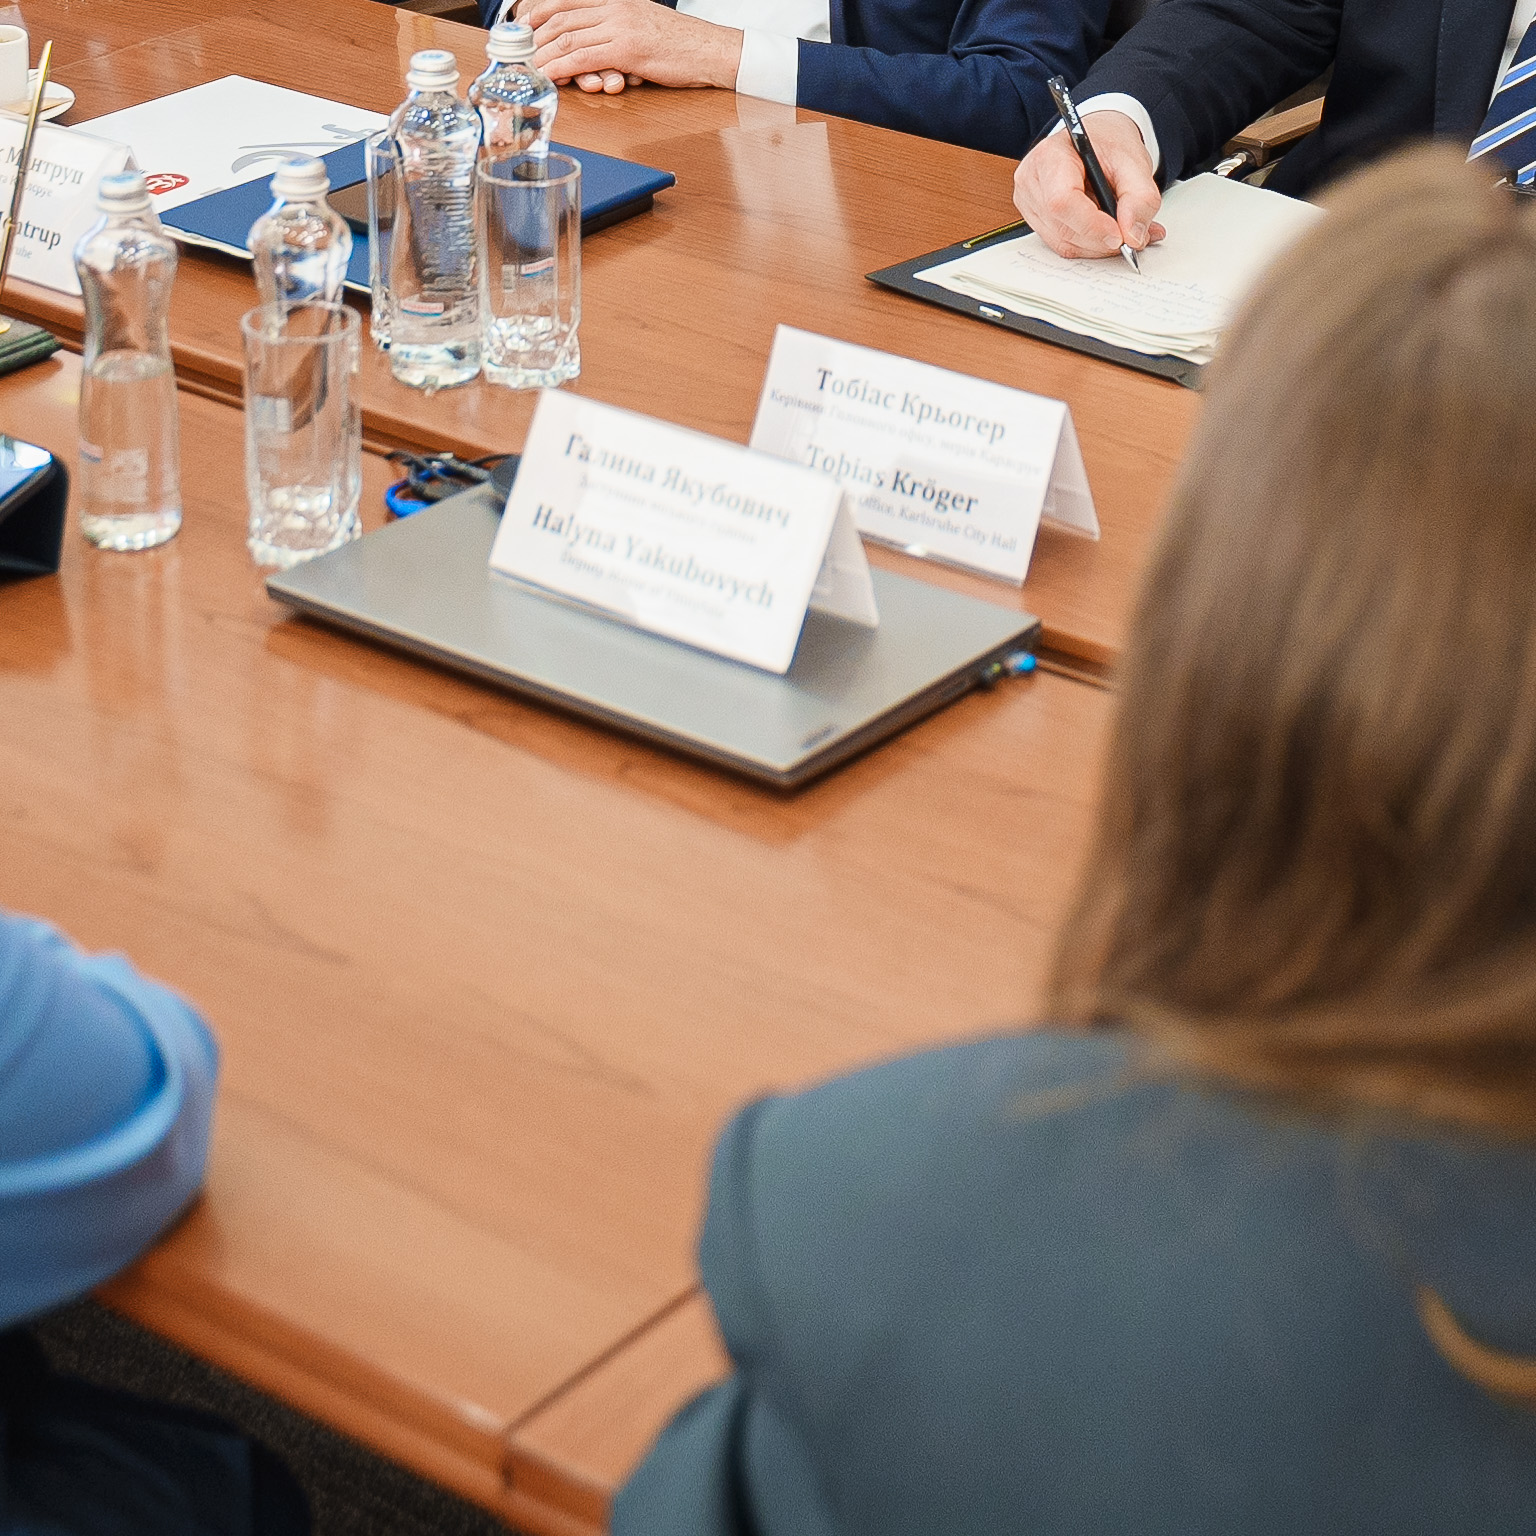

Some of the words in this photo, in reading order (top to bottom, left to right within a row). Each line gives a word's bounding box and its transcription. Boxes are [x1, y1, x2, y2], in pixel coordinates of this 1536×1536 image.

[5, 146, 85, 186] Мнтруп
[816, 367, 897, 410] Тобіас
[900, 391, 1006, 445] Крьогер
[564, 433, 656, 484] Галина
[660, 465, 792, 529] Якубович
[806, 443, 884, 488] Tobias
[891, 470, 980, 515] Kröger
[531, 503, 616, 552] Halyna
[623, 534, 776, 610] Yakubovych
